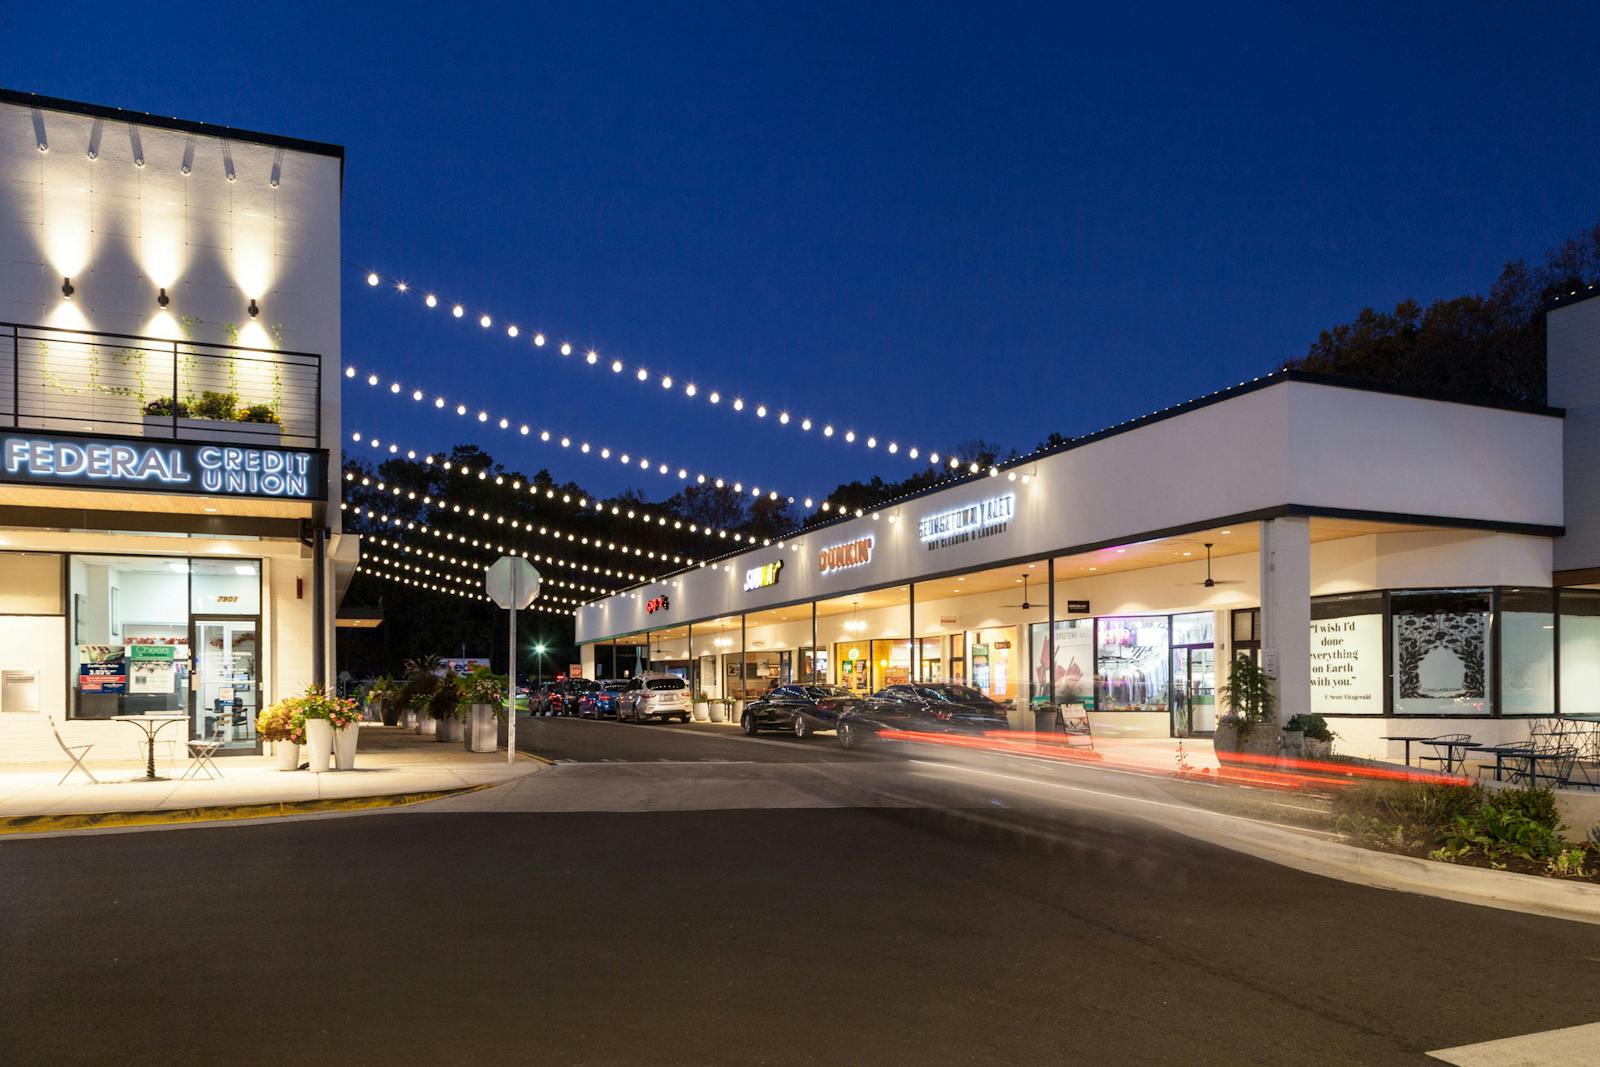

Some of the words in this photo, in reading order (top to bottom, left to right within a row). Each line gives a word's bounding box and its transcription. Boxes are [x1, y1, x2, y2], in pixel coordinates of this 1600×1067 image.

[5, 438, 191, 481] FEDERAL
[198, 446, 311, 474] CREDIT
[202, 470, 308, 496] UNION
[918, 506, 979, 540] GEORGETOWN
[980, 496, 1013, 523] VALET
[744, 559, 784, 592] SUBWAY
[1320, 622, 1341, 633] wish
[1321, 637, 1344, 646] done
[1326, 663, 1353, 673] Earth
[1310, 676, 1331, 686] with
